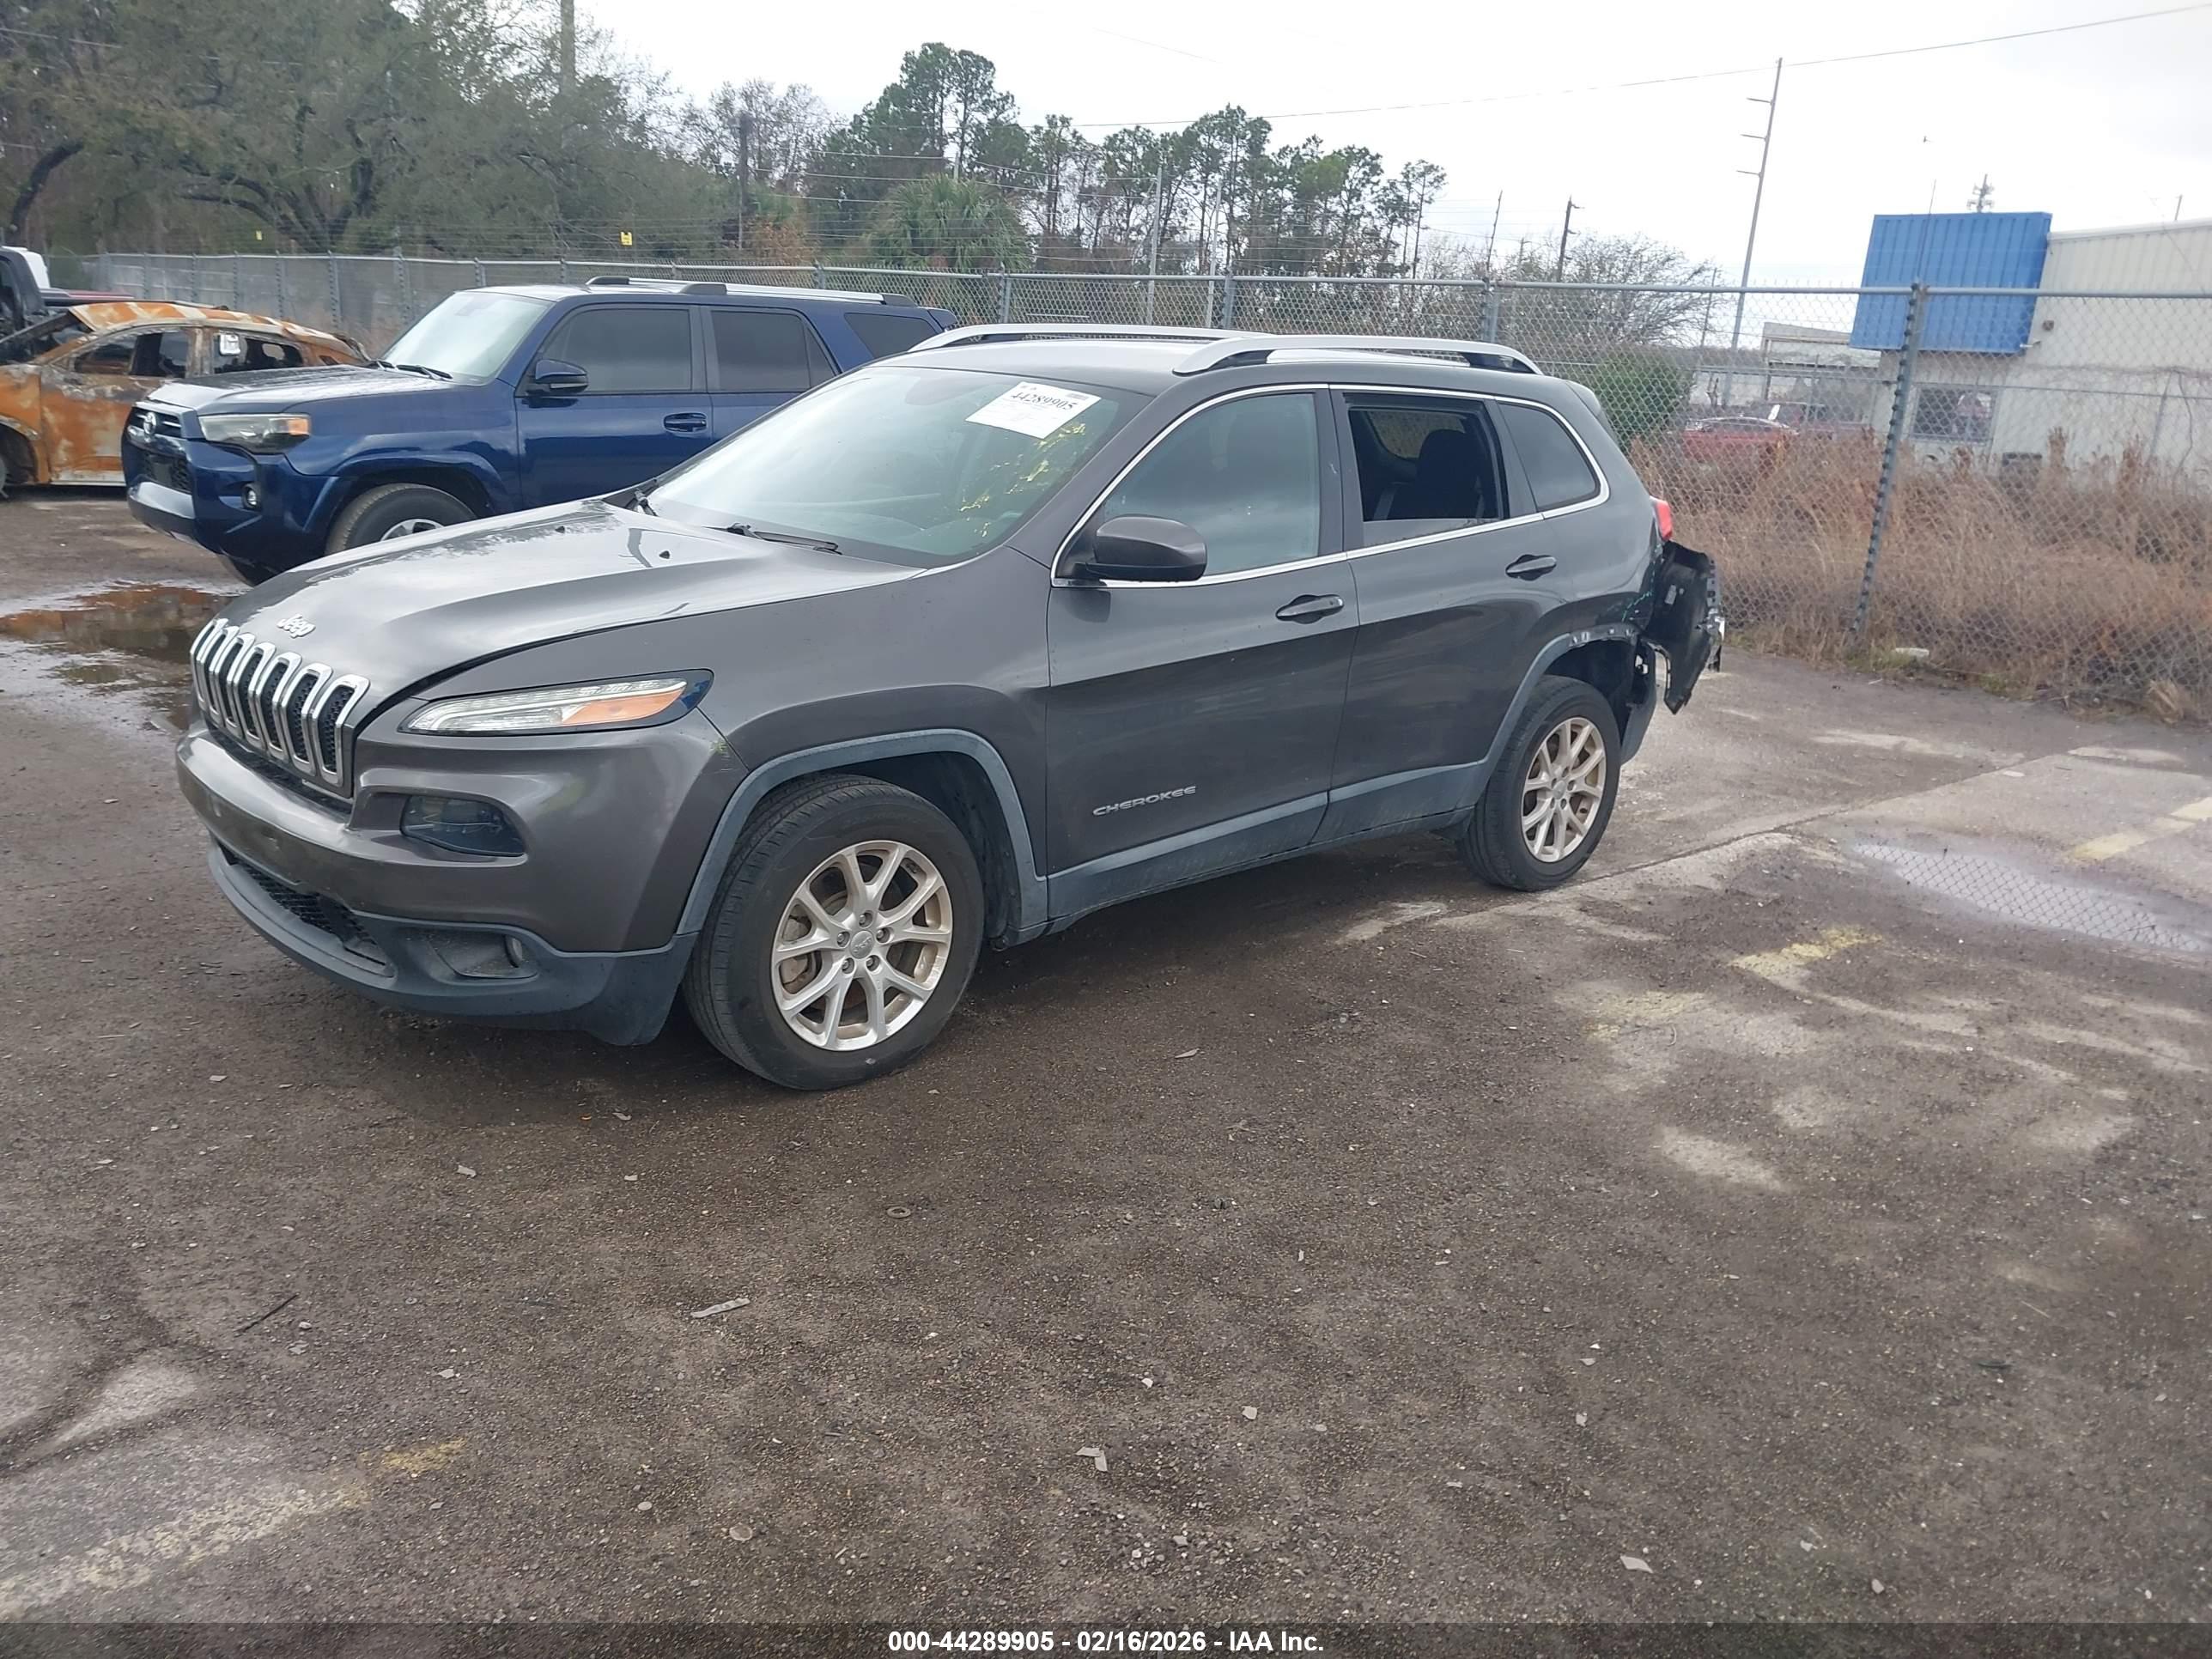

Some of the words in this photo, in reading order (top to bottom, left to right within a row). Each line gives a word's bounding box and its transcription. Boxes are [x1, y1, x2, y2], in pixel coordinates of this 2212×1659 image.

[1012, 392, 1079, 410] 44289905
[276, 613, 317, 639] Jeep
[1092, 785, 1197, 817] CHEROKEE
